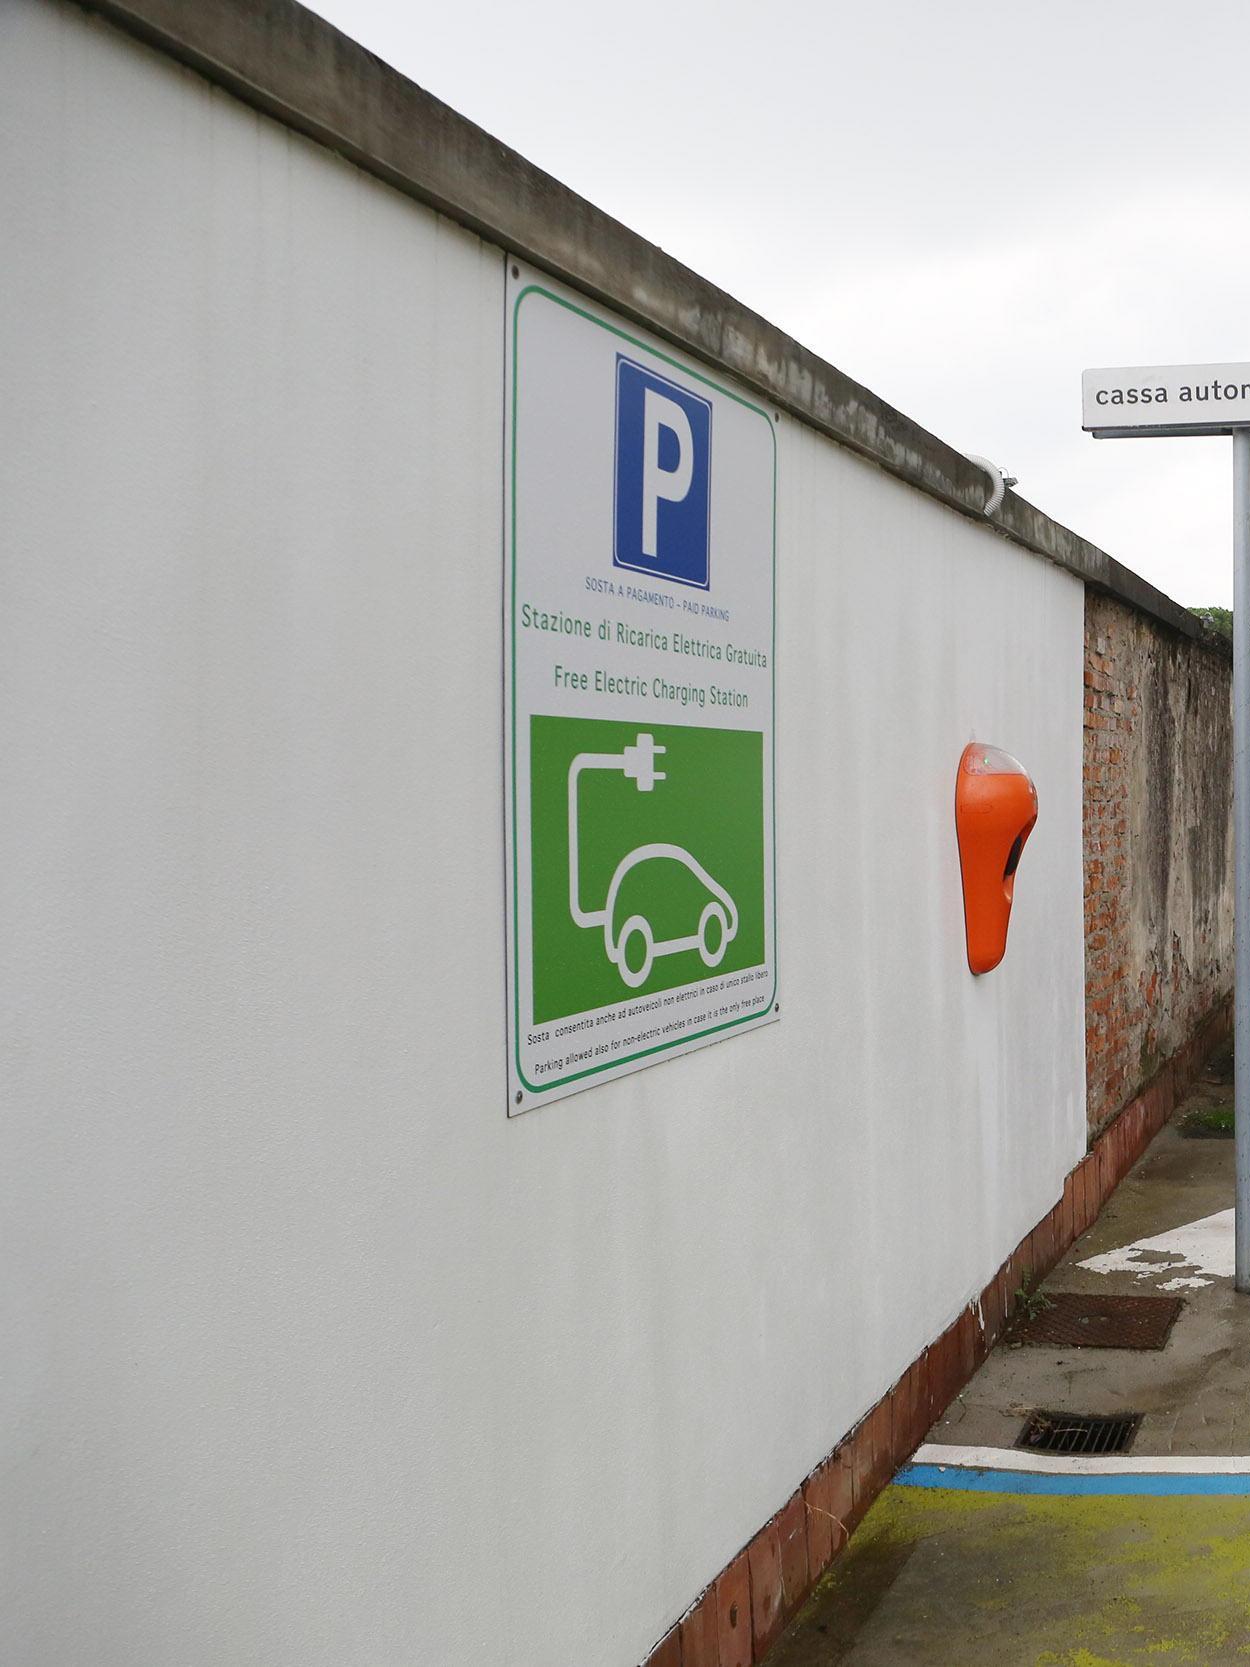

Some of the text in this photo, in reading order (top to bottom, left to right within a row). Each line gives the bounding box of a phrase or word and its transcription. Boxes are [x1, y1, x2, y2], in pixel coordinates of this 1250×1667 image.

[1096, 386, 1168, 405] cassa
[642, 387, 694, 557] P
[585, 576, 614, 594] SOSTA
[626, 587, 674, 609] PAGAMENTO
[683, 600, 699, 614] PAID
[701, 605, 729, 622] PARKING
[522, 604, 767, 668] Stazione di Ricarica Elettrica Gratuita
[555, 665, 749, 708] Free Electric Charging Station
[527, 1032, 550, 1045] Sosta
[555, 1019, 594, 1037] consentita
[596, 1011, 616, 1025] anche
[618, 1008, 626, 1019] ad
[628, 998, 662, 1016] autoveicoli
[664, 995, 675, 1004] non
[676, 990, 698, 1003] elettrici
[707, 983, 719, 994] caso
[534, 1057, 563, 1075] Parking
[566, 1046, 593, 1065] allowed
[595, 1042, 609, 1056] also
[611, 1039, 621, 1050] for
[623, 1027, 660, 1046] non-electric
[662, 1020, 686, 1034] vehicles
[694, 1015, 706, 1024] case
[730, 1002, 740, 1013] only
[741, 999, 751, 1009] free
[752, 995, 765, 1006] place
